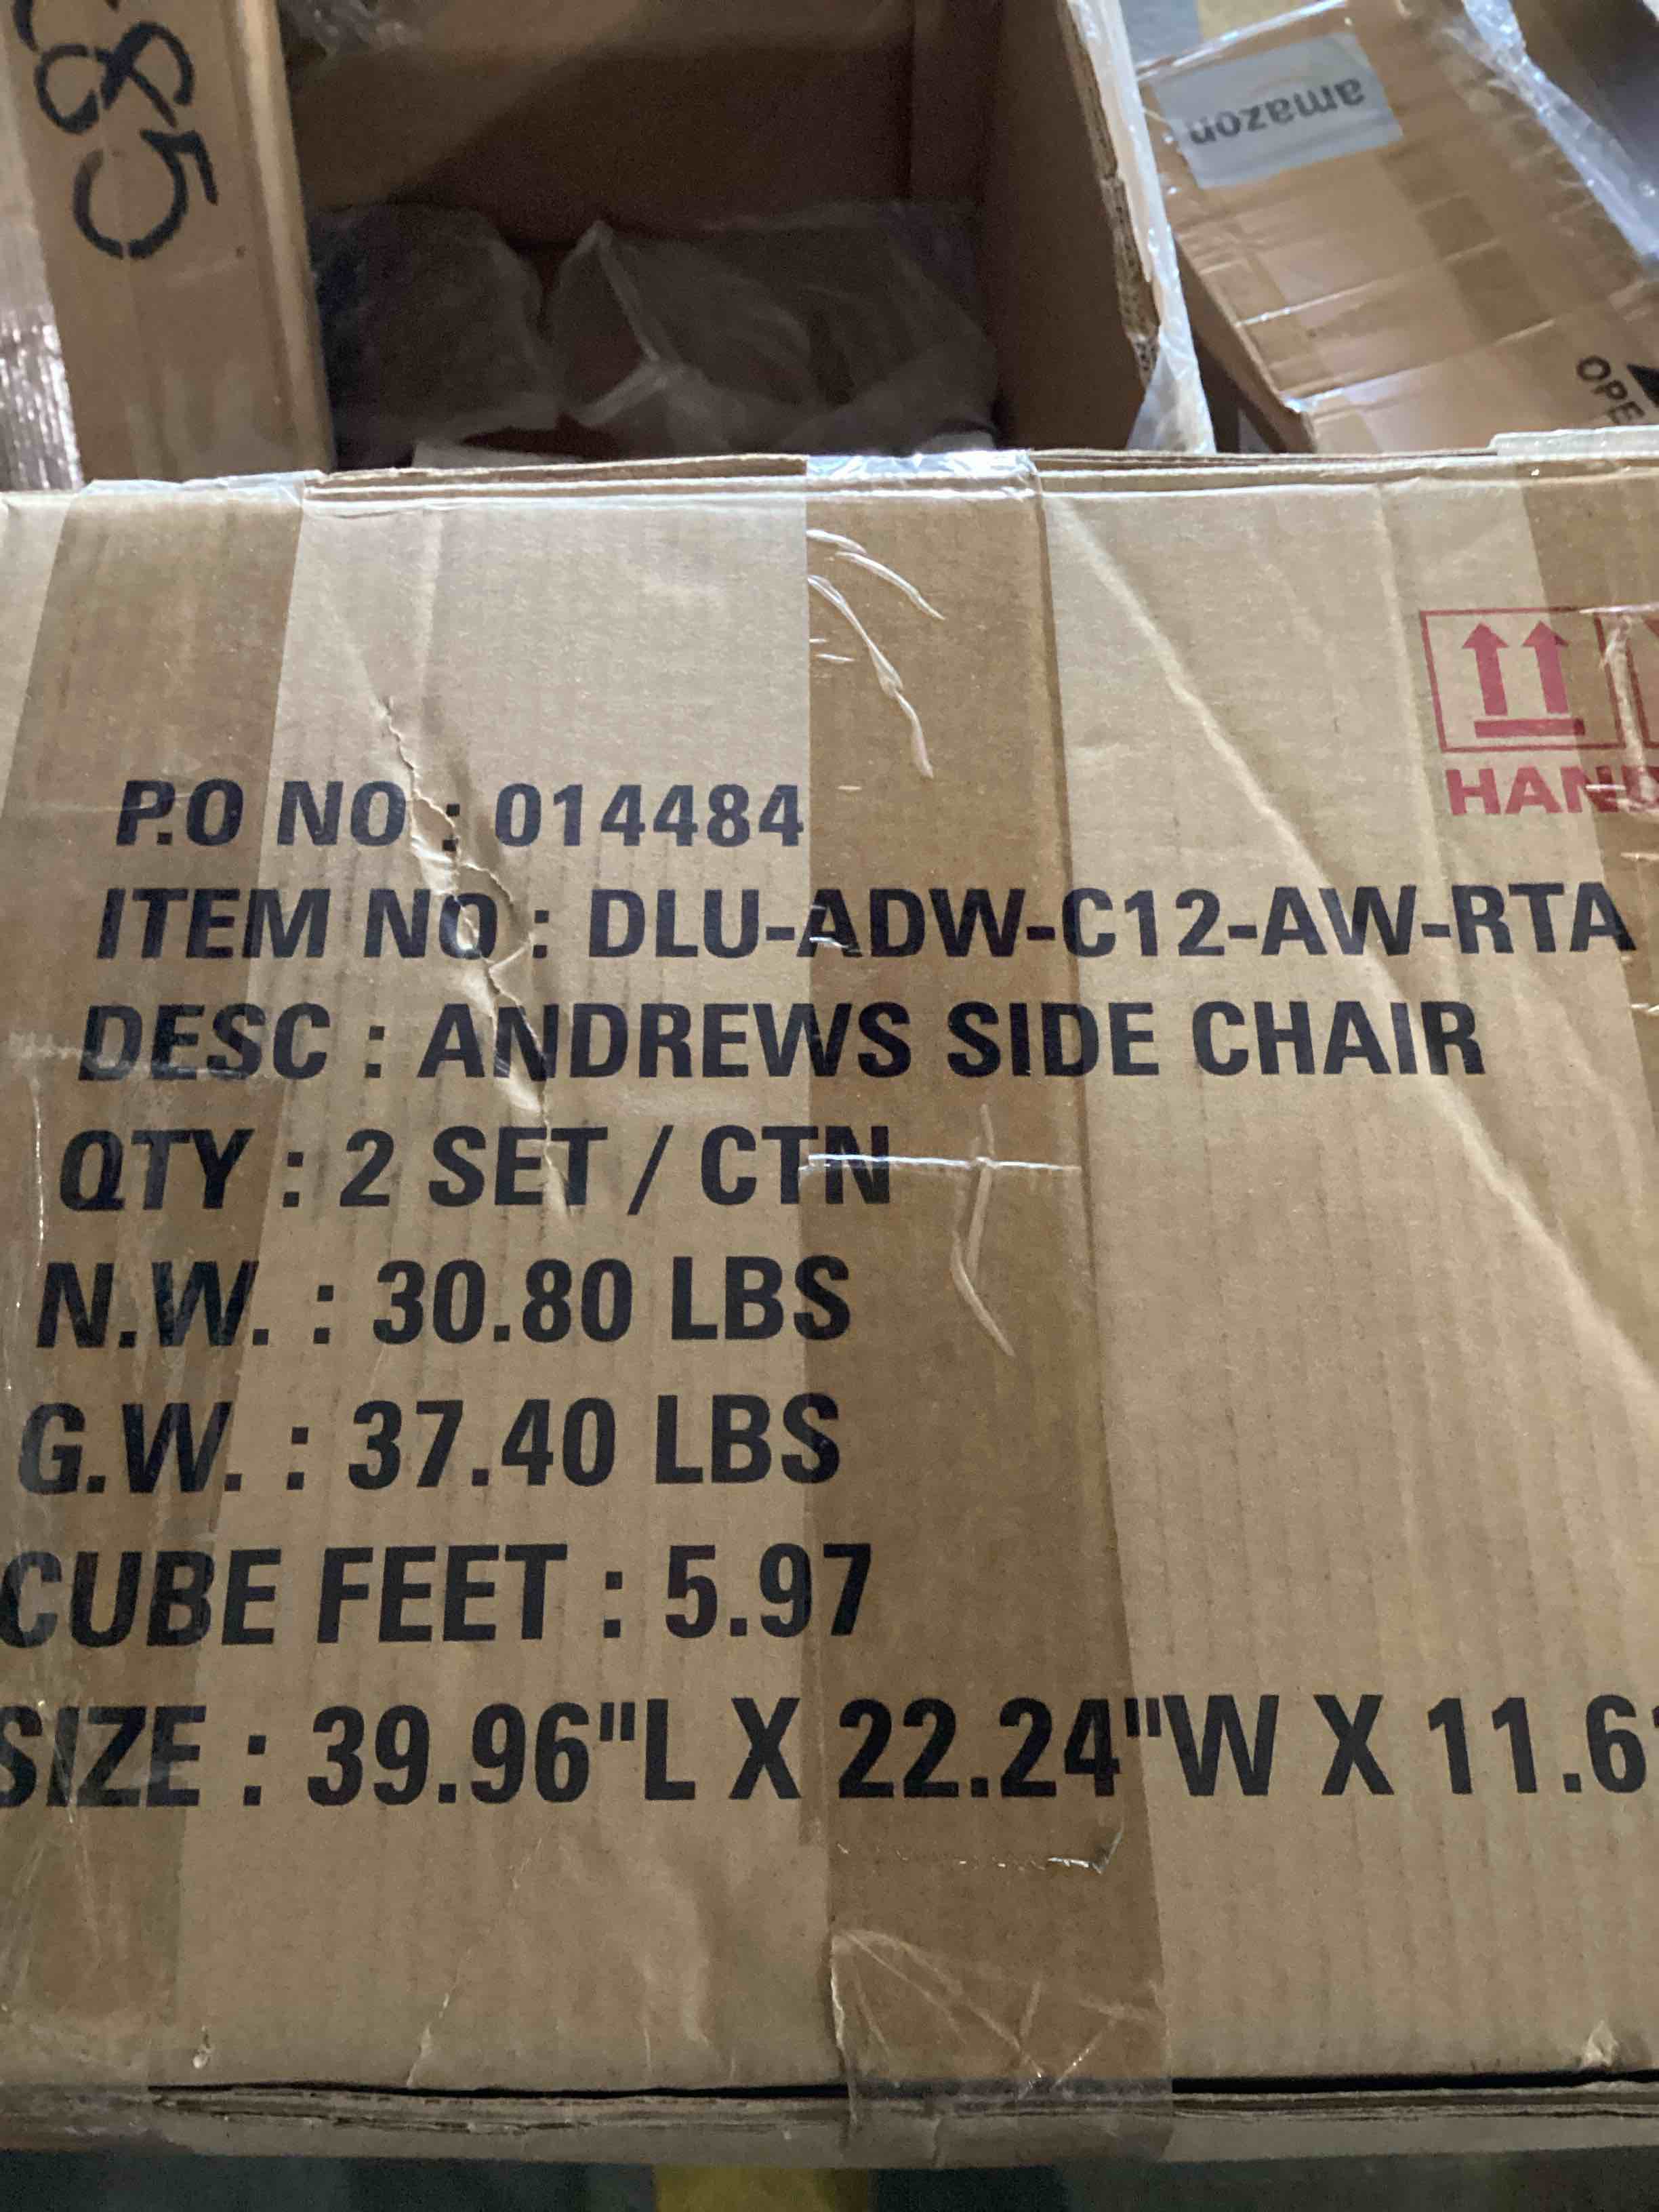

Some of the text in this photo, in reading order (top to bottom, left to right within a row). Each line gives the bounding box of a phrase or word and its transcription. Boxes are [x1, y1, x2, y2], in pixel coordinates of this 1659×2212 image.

[1189, 77, 1367, 146] amazon
[116, 778, 244, 847] P.O
[276, 780, 407, 847] NO
[495, 783, 804, 847] 014484
[96, 888, 331, 959] ITEM
[363, 888, 498, 960] NO
[588, 881, 1637, 959] DLU-ADW-C12-AW-RTA
[77, 1003, 331, 1082] DESC
[417, 1001, 912, 1082] ANDREWS
[947, 1001, 1160, 1078] SIDE
[1192, 1000, 1486, 1076] CHAIR
[59, 1128, 255, 1212] QTY
[428, 1125, 609, 1207] SET
[627, 1124, 674, 1216] /
[700, 1124, 890, 1206] CTN
[36, 1261, 270, 1349] N.W.
[373, 1258, 633, 1345] 30.80
[671, 1254, 851, 1341] LBS
[18, 1401, 243, 1494] G.W.
[348, 1397, 616, 1491] 37.40
[655, 1393, 841, 1485] LBS
[0, 1547, 282, 1649] CUBE
[316, 1543, 569, 1643] FEET
[664, 1542, 872, 1639] 5.97
[0, 1704, 207, 1808] SIZE
[306, 1698, 697, 1807] 39.96"L
[728, 1697, 802, 1800] X
[838, 1694, 1279, 1799] 22.24"W
[1313, 1694, 1395, 1796] X
[1427, 1694, 1659, 1795] 11.6
